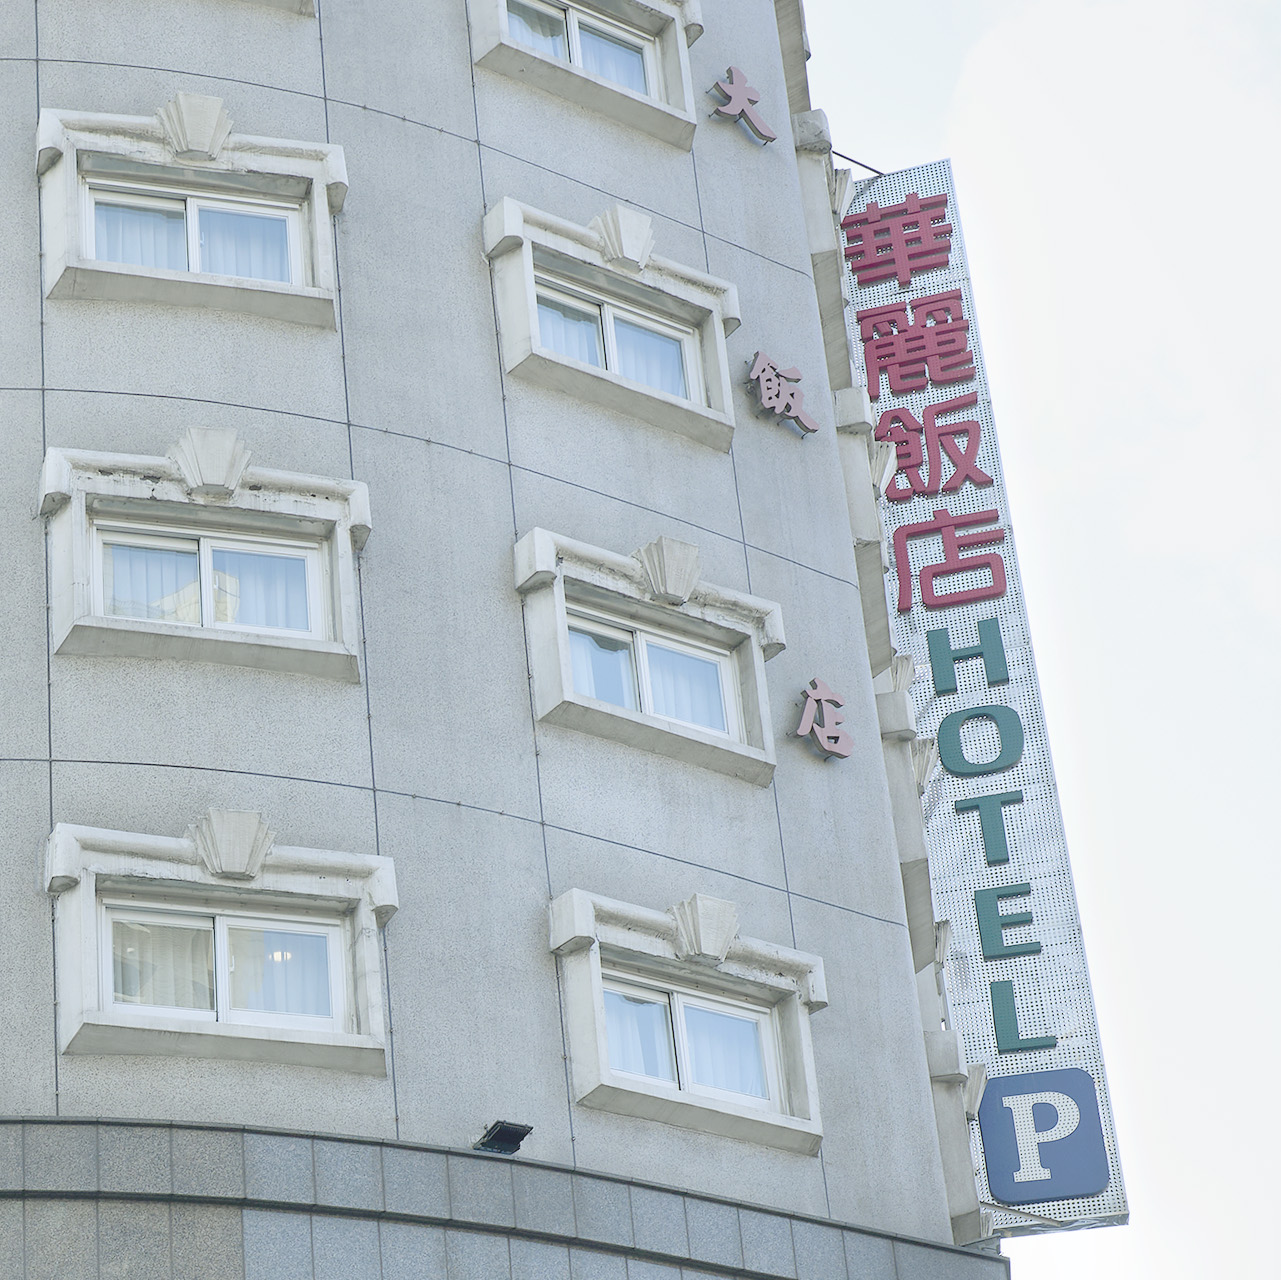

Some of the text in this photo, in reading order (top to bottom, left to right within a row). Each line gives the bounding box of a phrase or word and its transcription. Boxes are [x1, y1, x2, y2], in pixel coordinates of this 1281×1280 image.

[841, 192, 1007, 613] 華麗飯店
[926, 617, 1057, 1055] HOTEL
[1001, 1090, 1081, 1183] P
